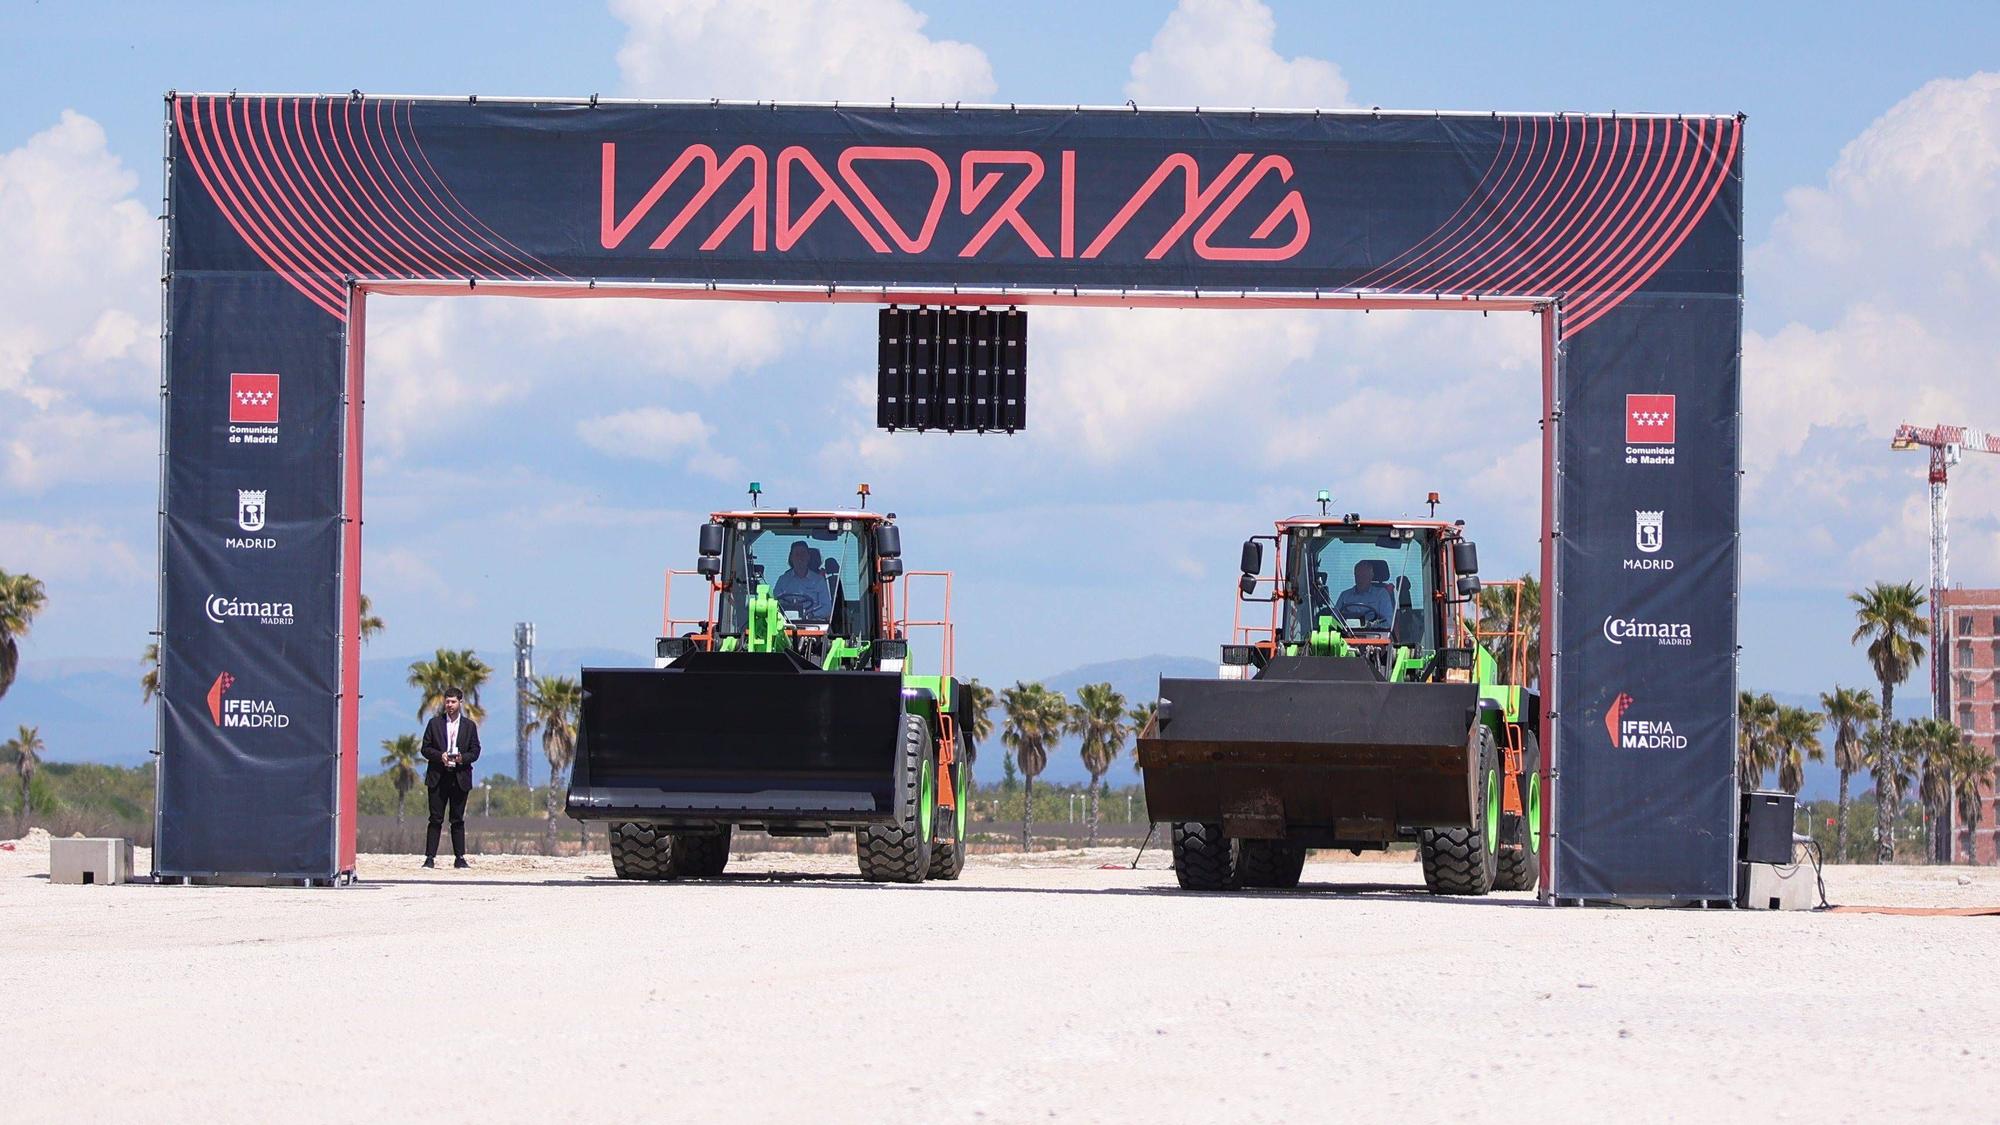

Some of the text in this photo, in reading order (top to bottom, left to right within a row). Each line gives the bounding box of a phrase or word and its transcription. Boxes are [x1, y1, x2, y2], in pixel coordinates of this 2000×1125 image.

[602, 143, 1310, 261] MADRING
[229, 425, 279, 434] Comunidad
[229, 434, 278, 444] de Madrid
[1625, 446, 1675, 455] Comunidad
[1625, 455, 1675, 464] de Madrid
[225, 538, 277, 549] MADRID
[1623, 559, 1674, 570] MADRID
[212, 597, 294, 617] Cámara
[260, 617, 294, 625] MADRID
[1610, 618, 1692, 638] Cámara
[1658, 638, 1692, 646] MADRID
[224, 700, 276, 713] IFEMA
[224, 714, 290, 728] MADRID
[1622, 720, 1674, 734] IFEMA
[1622, 734, 1688, 749] MADRID
